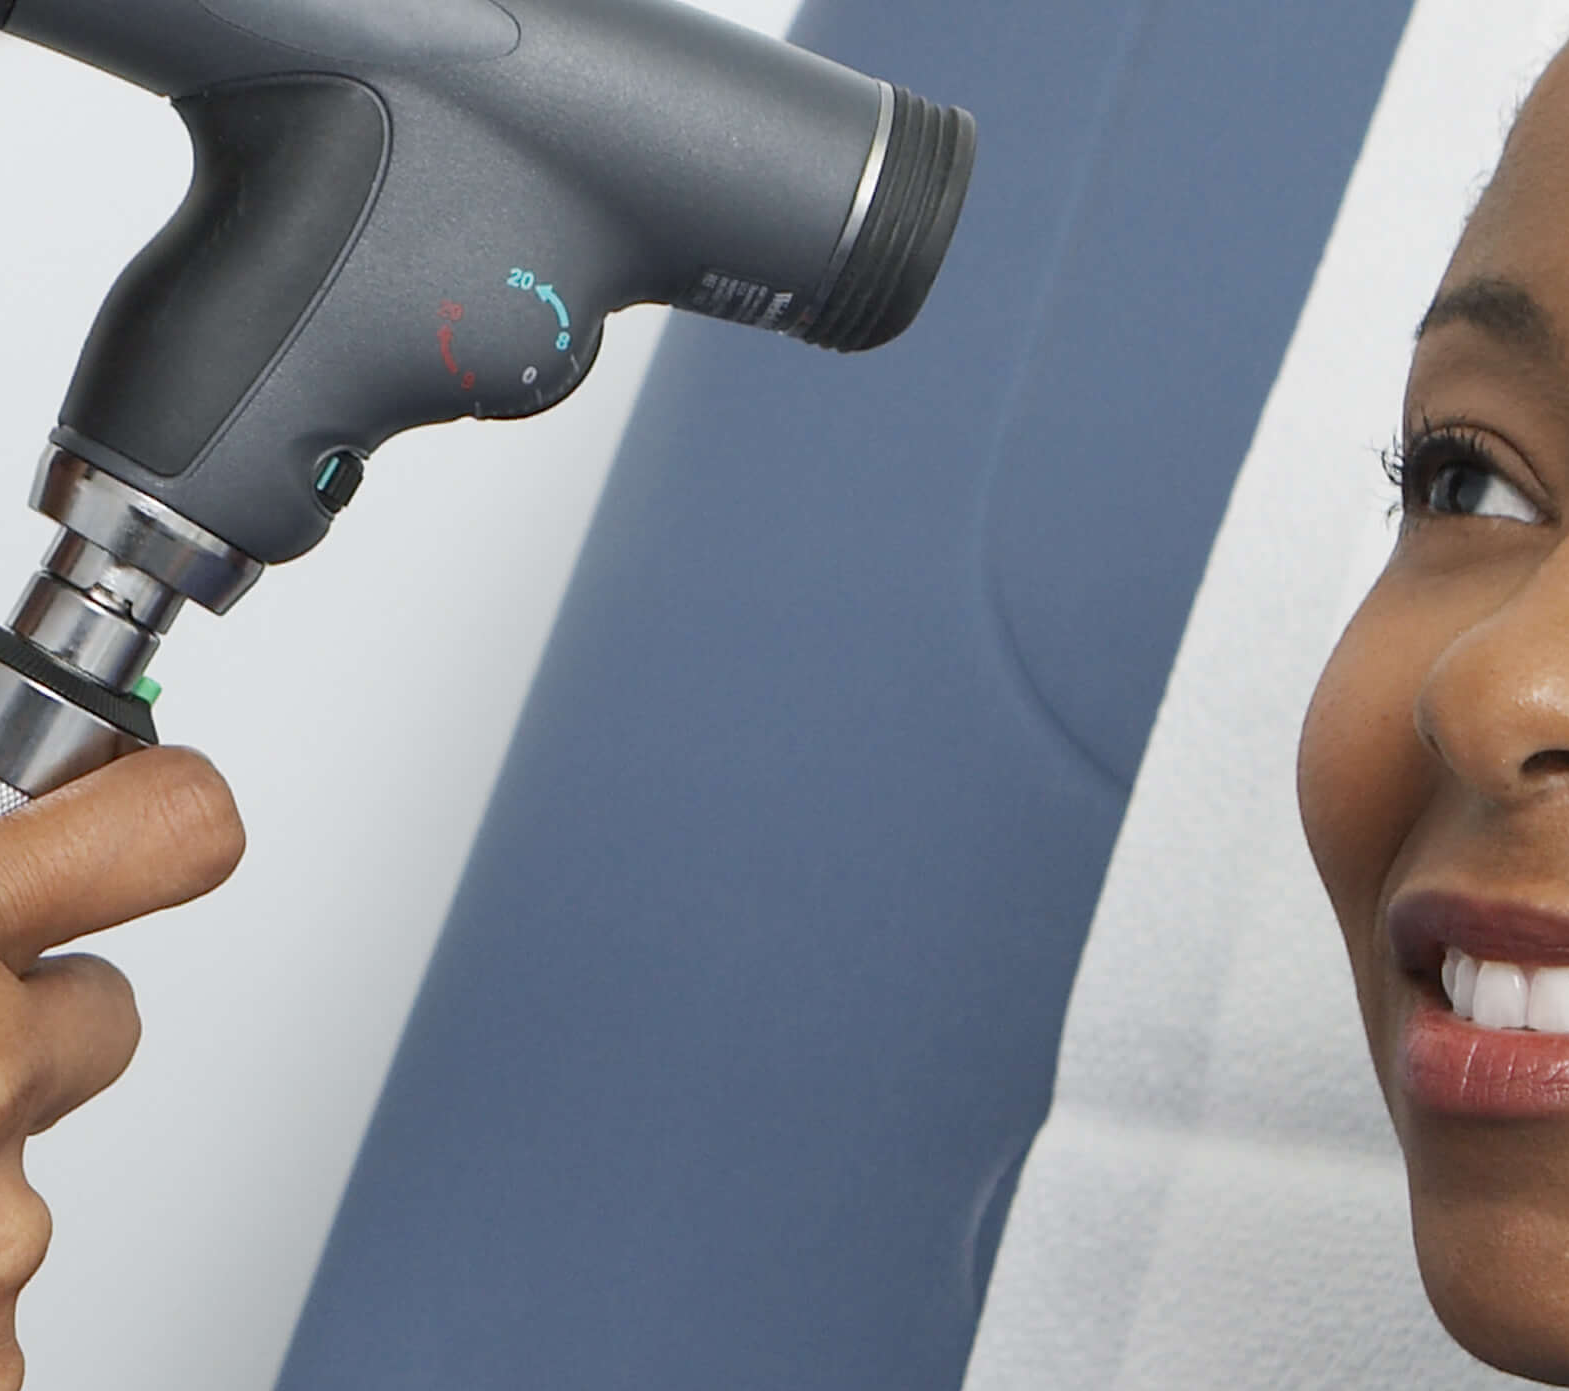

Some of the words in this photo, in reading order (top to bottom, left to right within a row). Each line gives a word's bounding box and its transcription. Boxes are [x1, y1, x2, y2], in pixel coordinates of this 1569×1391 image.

[506, 267, 535, 291] 20
[555, 331, 571, 351] 8
[521, 366, 538, 385] 0
